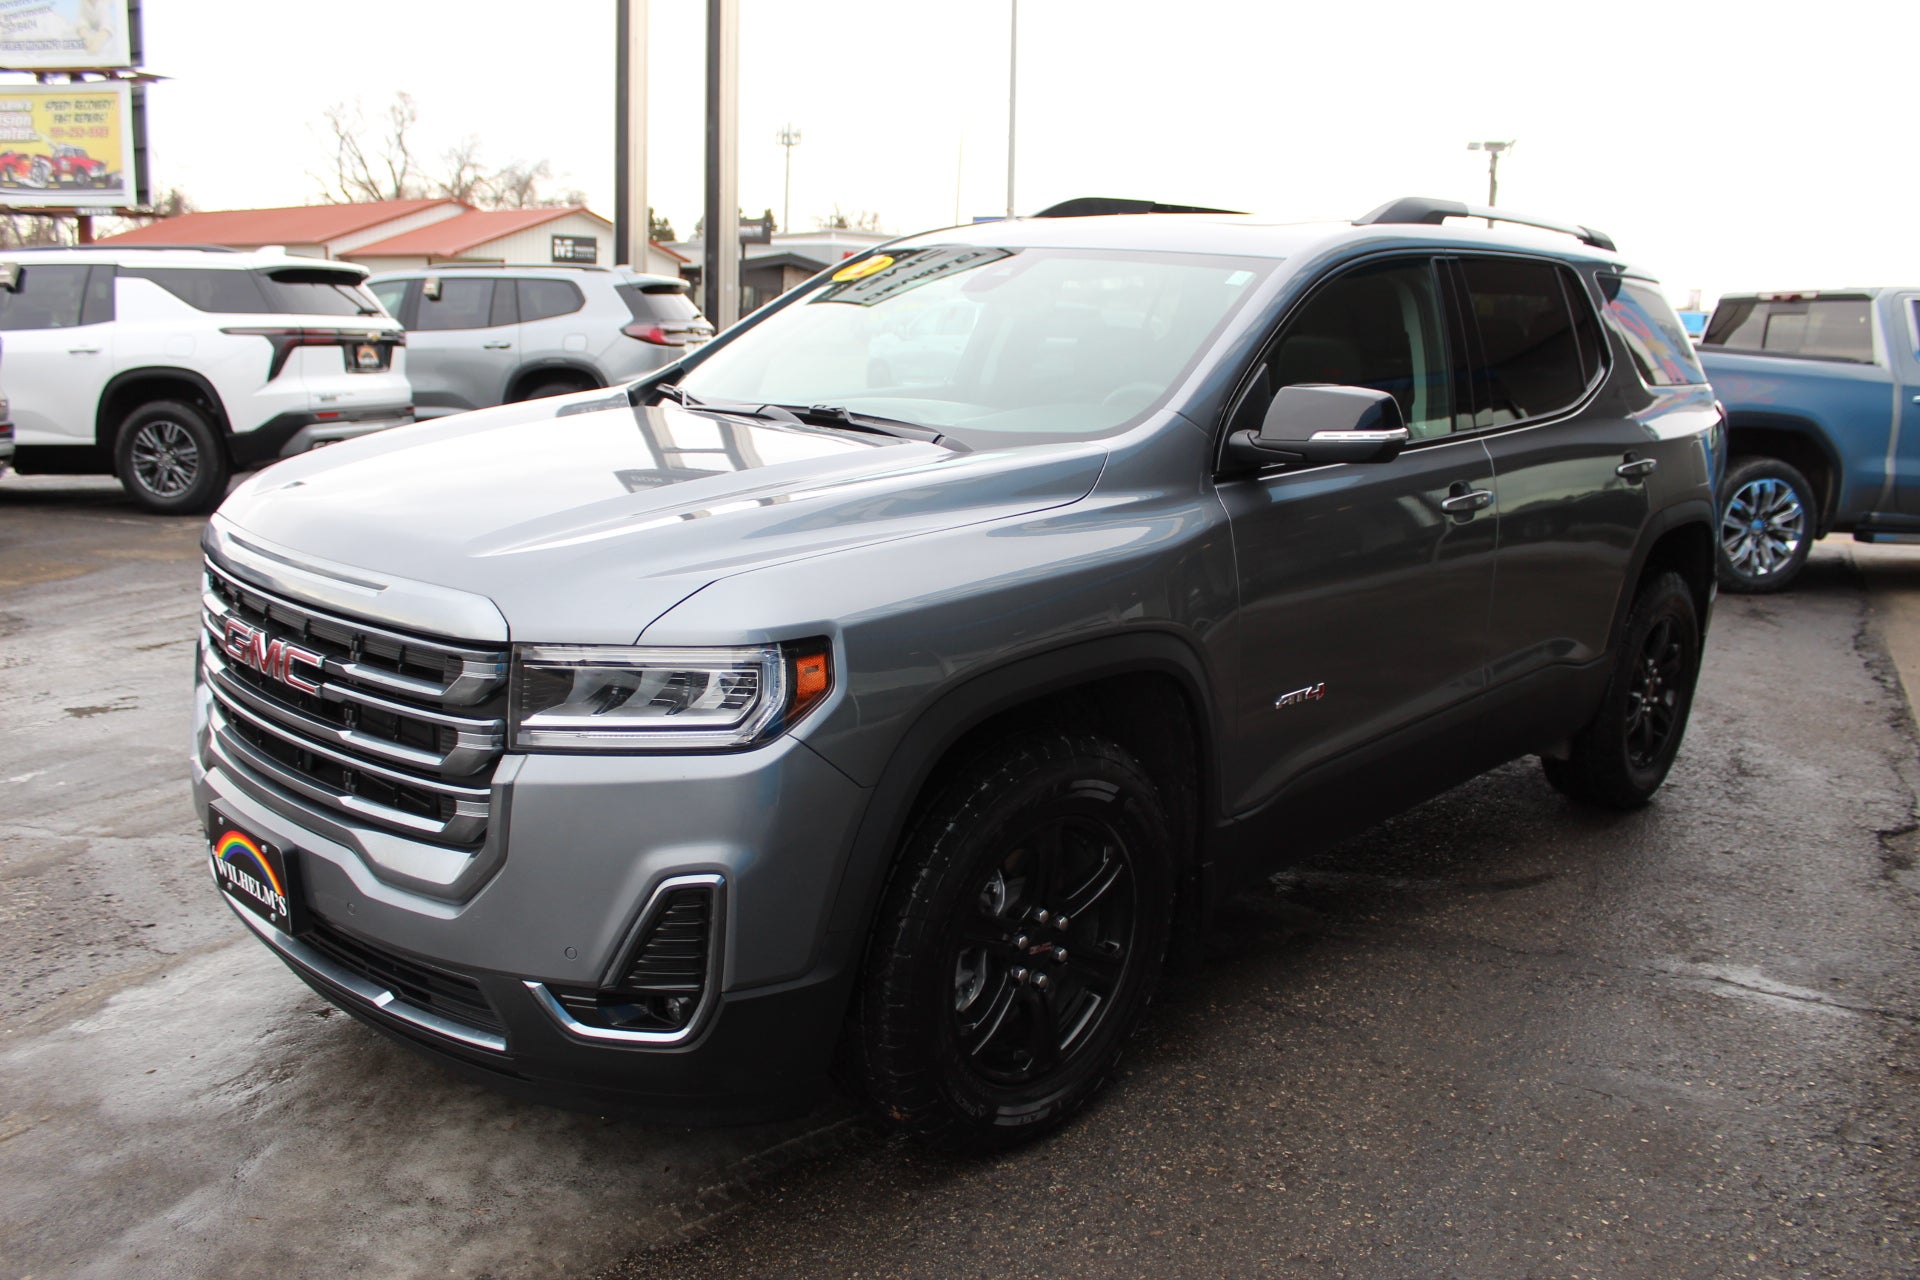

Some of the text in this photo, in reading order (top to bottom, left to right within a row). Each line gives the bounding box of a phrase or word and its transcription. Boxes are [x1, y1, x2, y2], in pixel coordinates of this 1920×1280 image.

[225, 616, 327, 698] GMC
[1275, 682, 1326, 710] AT4
[212, 847, 288, 917] WILHELM'S
